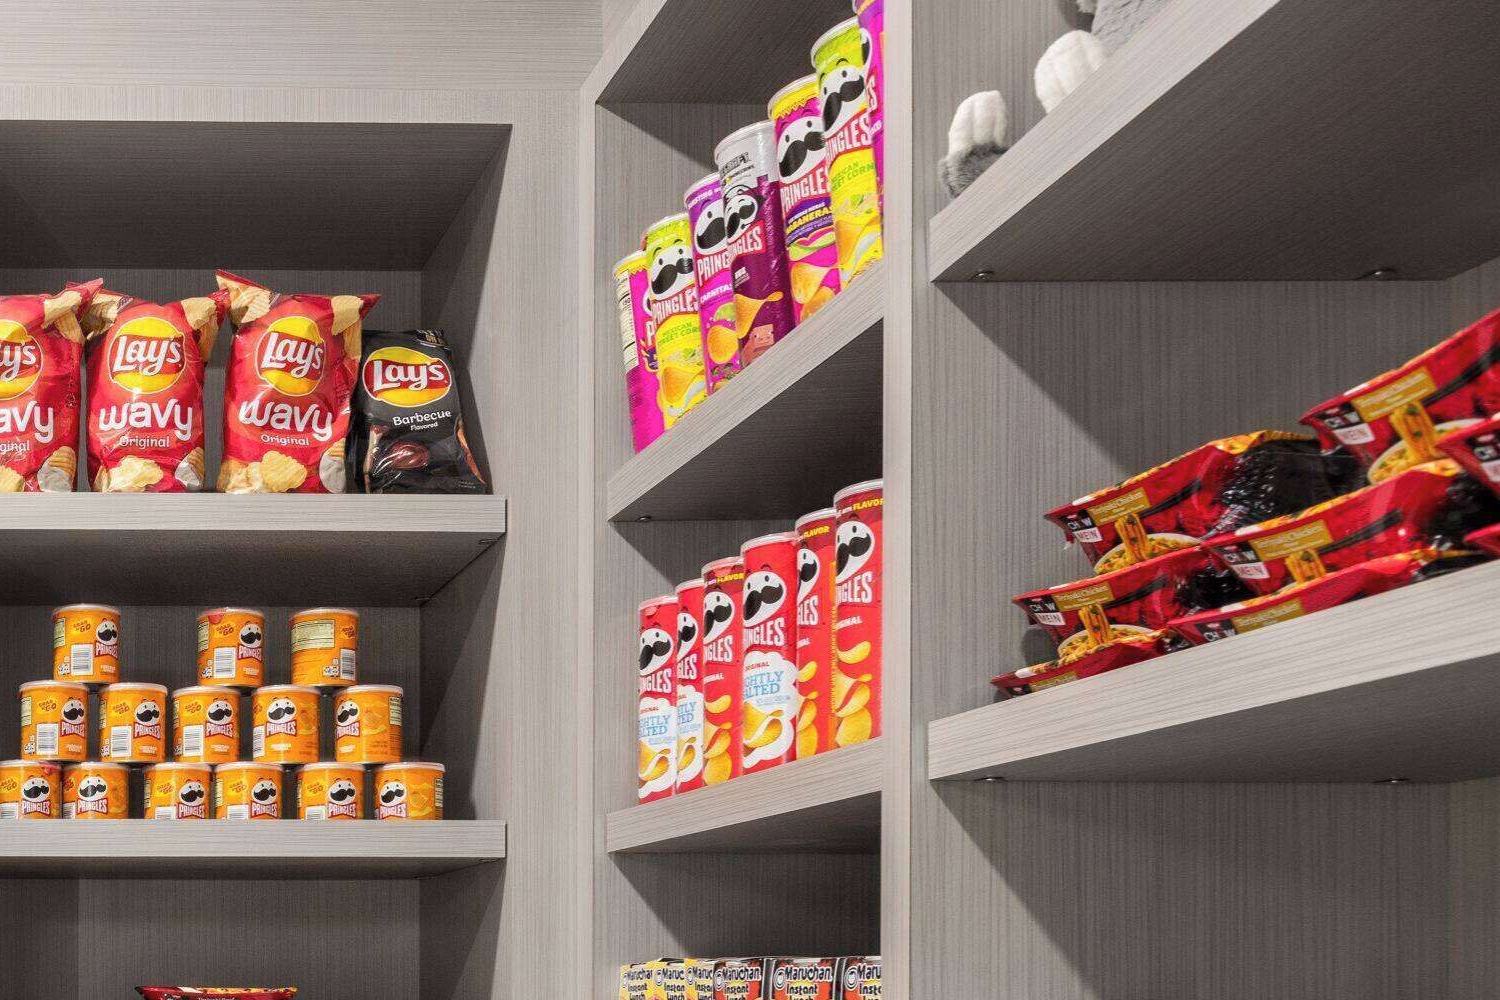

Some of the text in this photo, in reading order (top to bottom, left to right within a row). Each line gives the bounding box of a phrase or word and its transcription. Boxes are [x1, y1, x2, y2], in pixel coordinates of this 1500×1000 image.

[112, 335, 182, 376] Lay's
[261, 332, 323, 378] Lay's
[373, 360, 446, 392] Lay's
[99, 399, 193, 441] wavy
[237, 395, 333, 442] wavy
[392, 409, 452, 426] Barbecue
[120, 434, 170, 449] Original
[260, 433, 310, 447] Original
[1068, 516, 1092, 530] CHW
[77, 799, 108, 815] PRINGLES
[252, 803, 278, 817] PRINGLES
[722, 966, 761, 981] Maruchan
[785, 966, 832, 981] Maruchan
[786, 984, 818, 995] Instant
